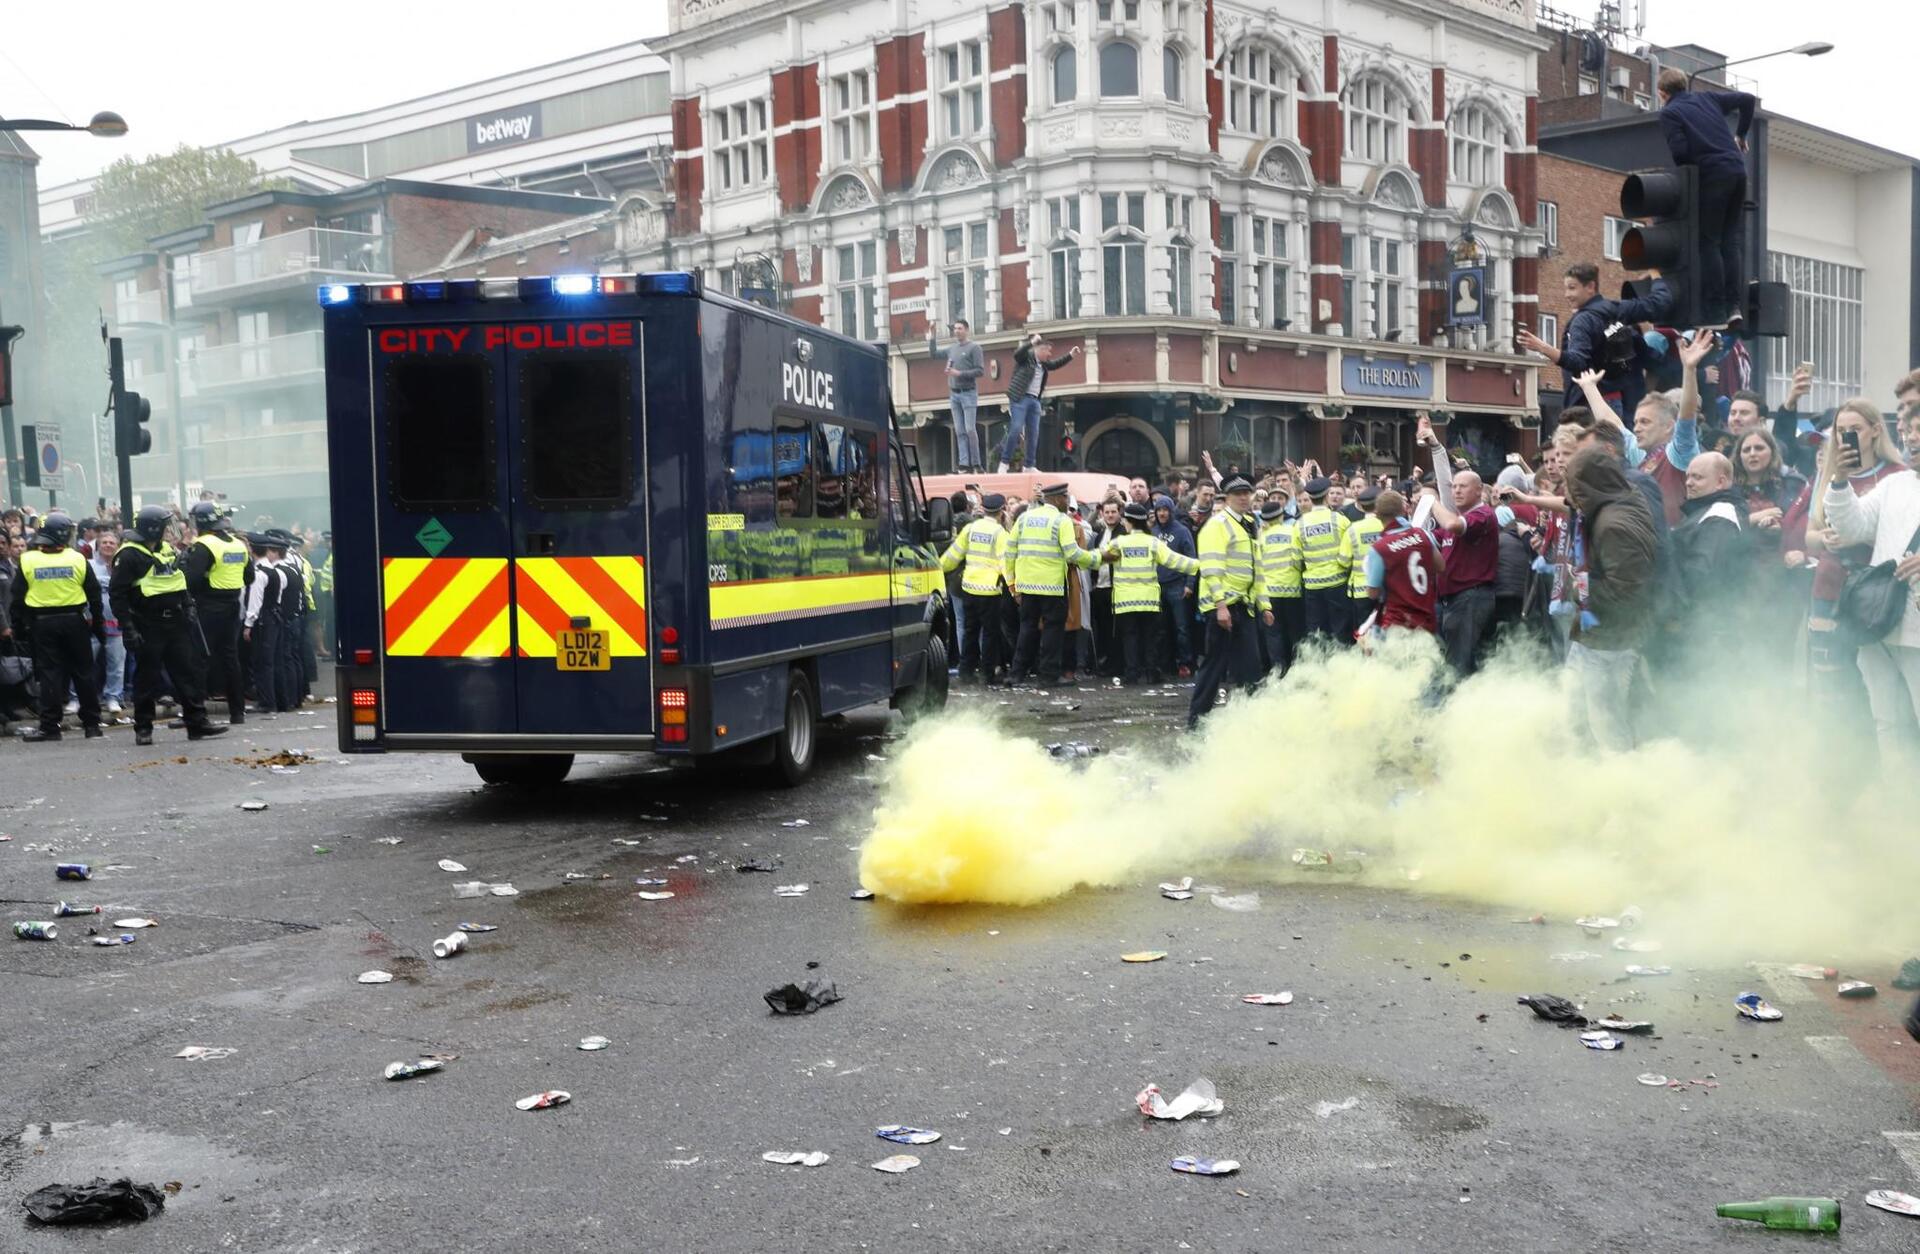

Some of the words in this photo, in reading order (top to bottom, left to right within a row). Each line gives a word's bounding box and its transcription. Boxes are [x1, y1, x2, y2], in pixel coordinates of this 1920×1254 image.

[476, 115, 532, 144] betway
[379, 328, 469, 353] CITY
[484, 322, 633, 350] POLICE
[783, 362, 834, 411] POLICE
[1359, 366, 1379, 385] THE
[1382, 367, 1421, 388] BOLEYN
[36, 568, 73, 579] POLICE
[1408, 551, 1428, 595] 6
[563, 632, 602, 649] LD12
[567, 650, 599, 667] OZW
